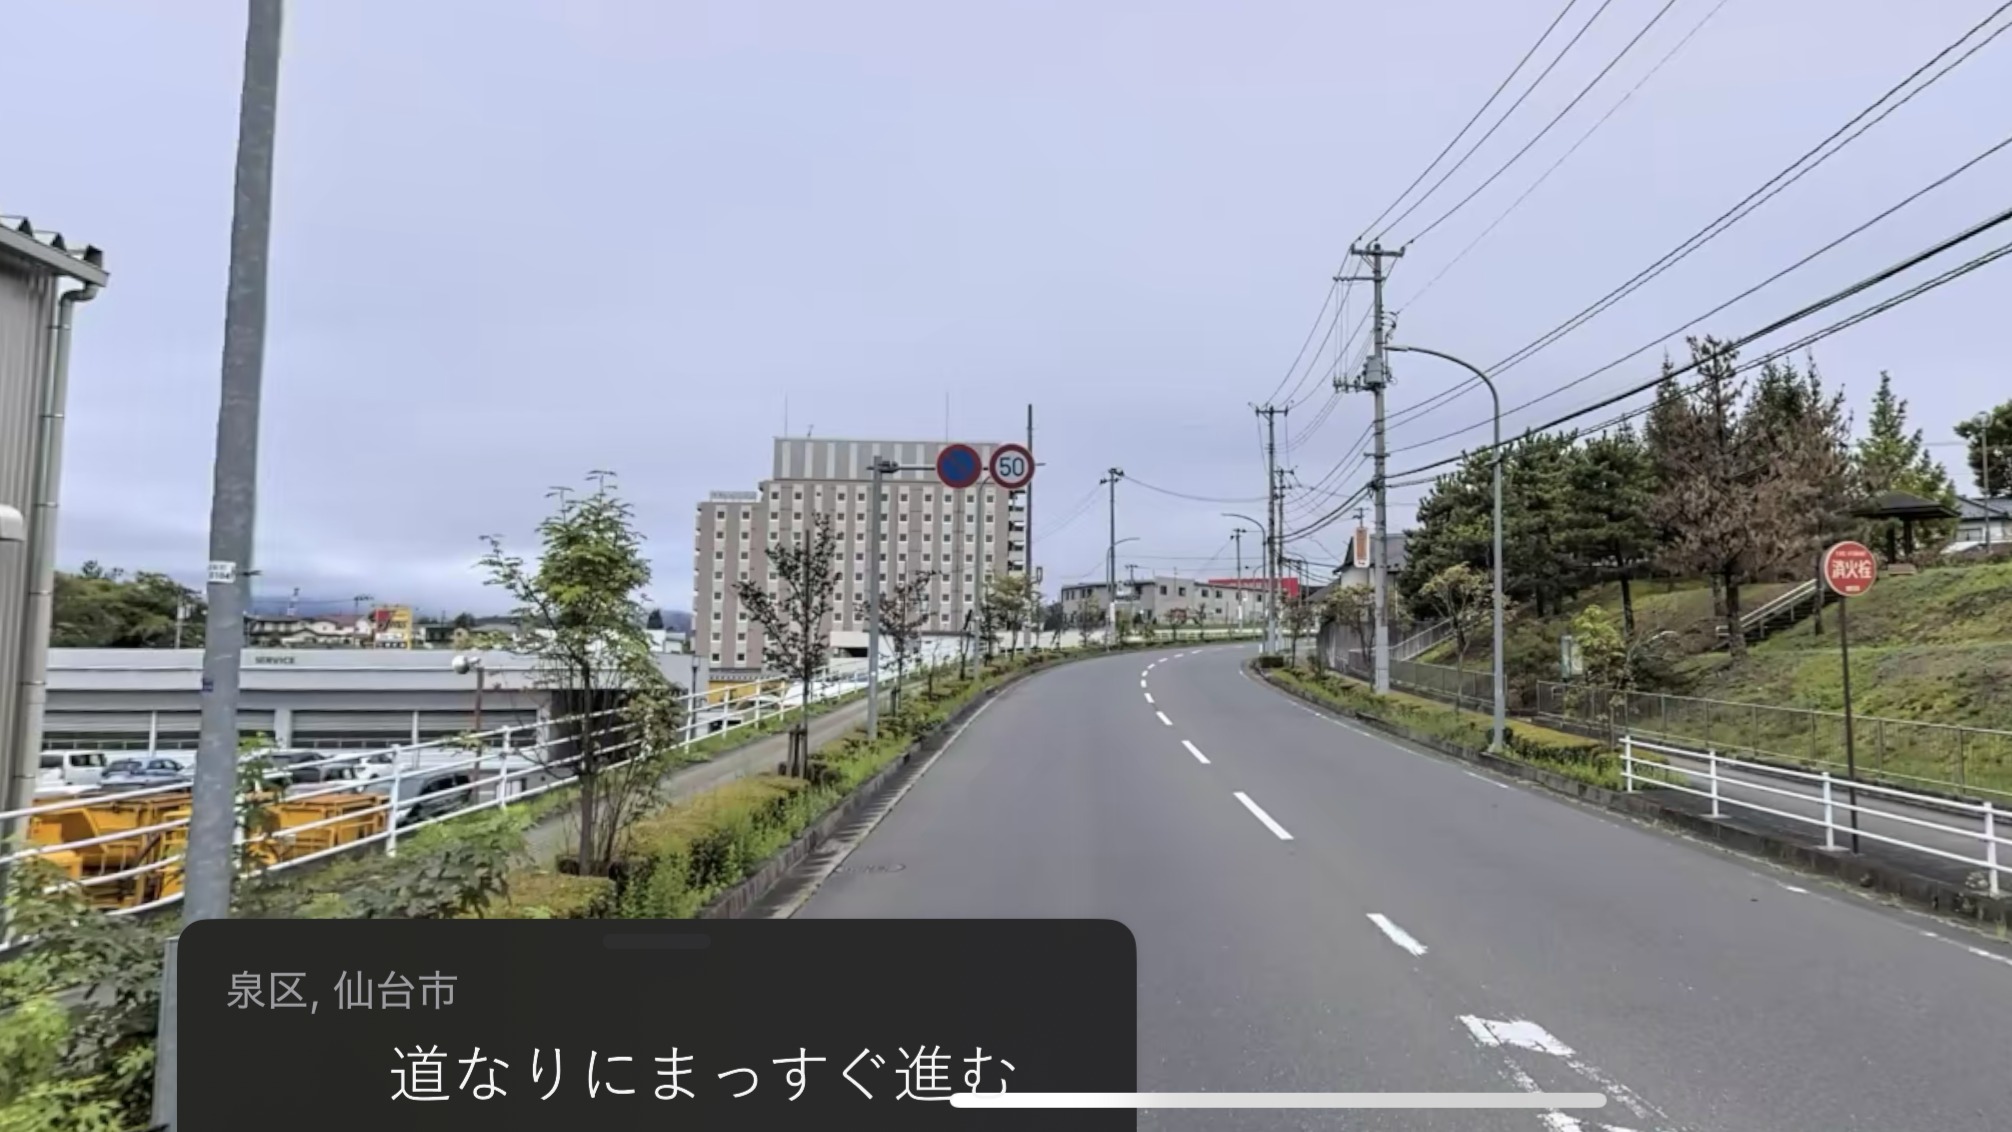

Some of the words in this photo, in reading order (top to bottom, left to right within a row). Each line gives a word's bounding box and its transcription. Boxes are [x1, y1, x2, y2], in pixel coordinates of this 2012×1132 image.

[1000, 457, 1024, 477] 50
[1832, 559, 1872, 579] 消火栓
